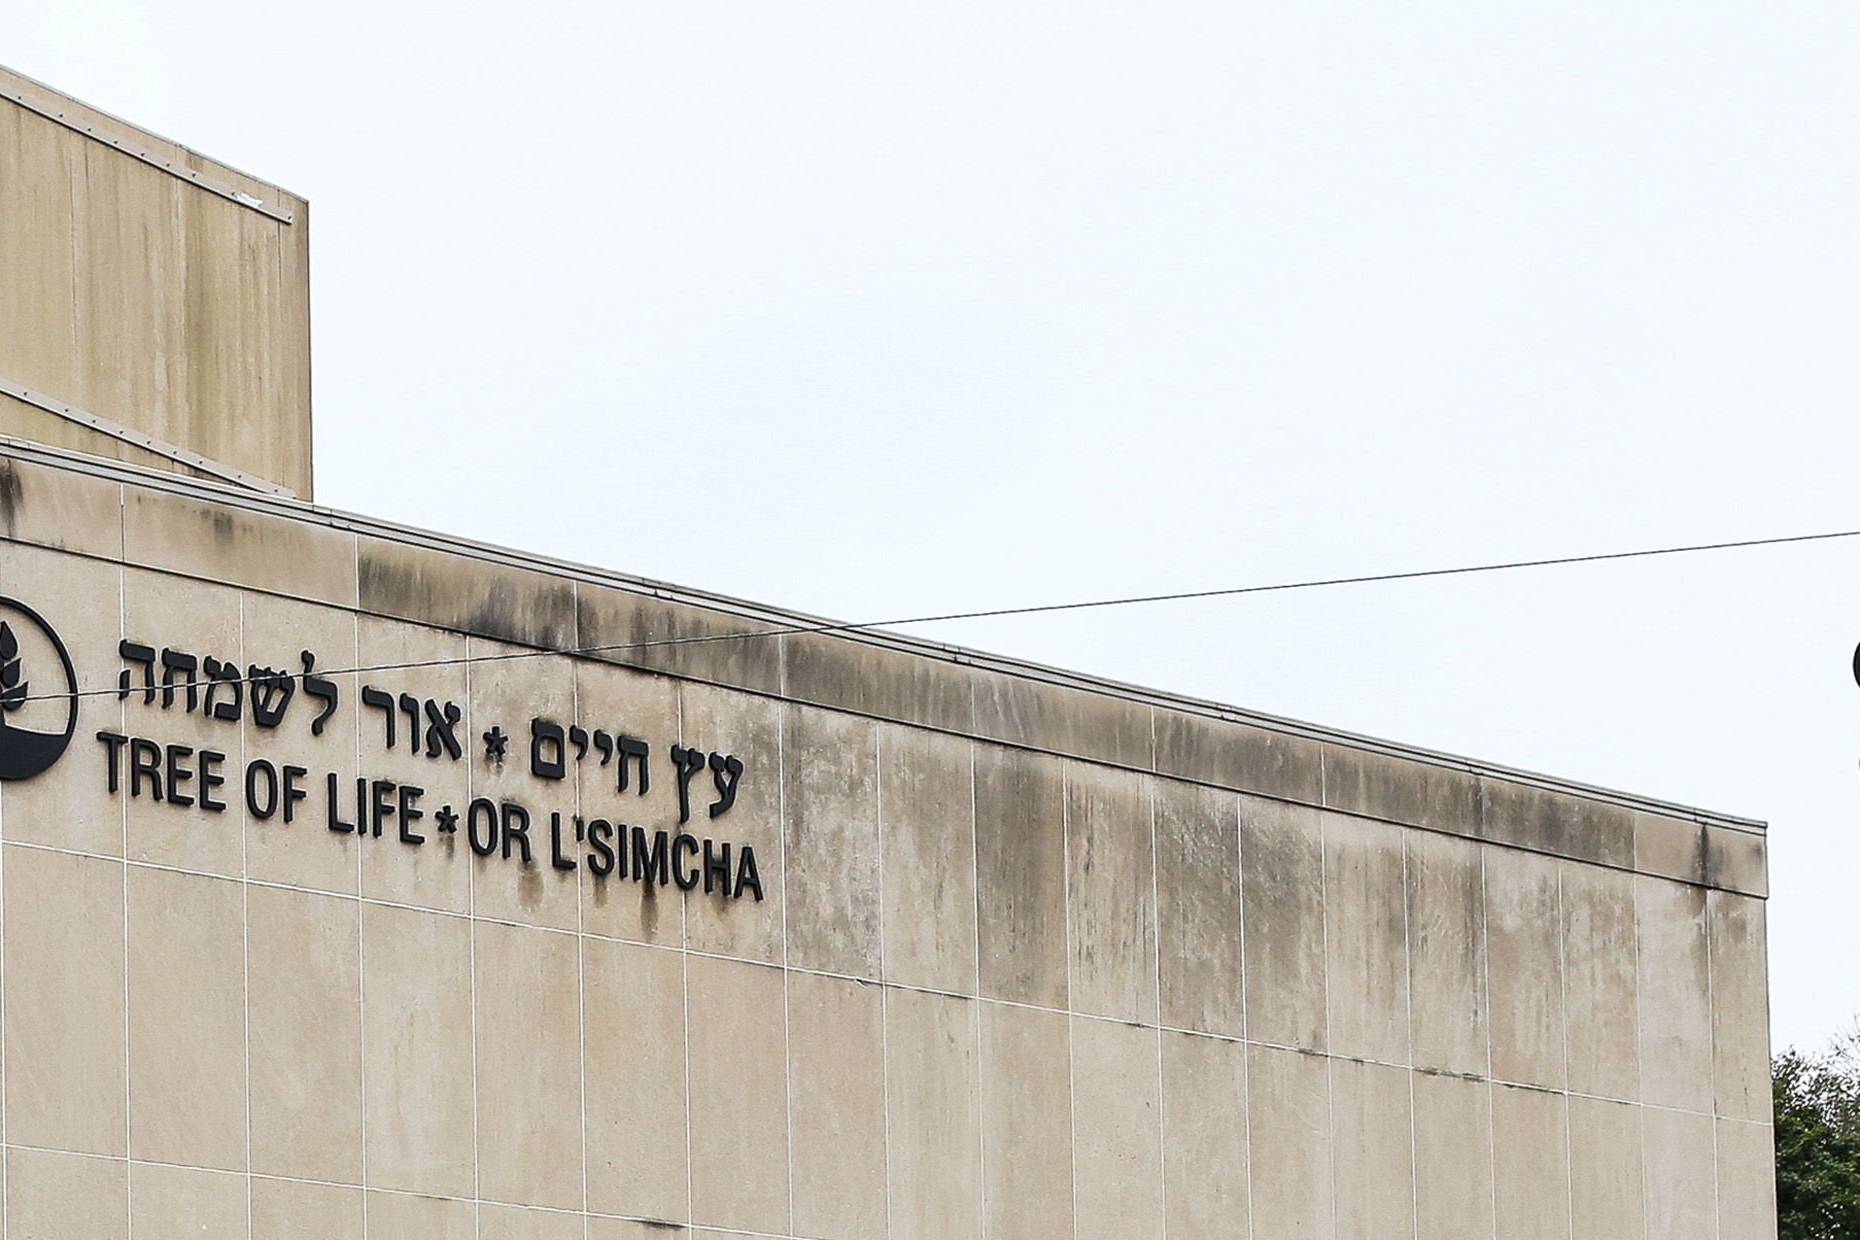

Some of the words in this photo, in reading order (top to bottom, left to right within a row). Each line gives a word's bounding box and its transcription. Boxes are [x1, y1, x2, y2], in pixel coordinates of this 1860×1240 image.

[119, 638, 338, 736] לשמחה
[362, 684, 461, 760] אור
[531, 717, 649, 795] חיים
[671, 744, 743, 823] עץ
[96, 731, 227, 811] TREE
[245, 758, 308, 824] OF
[327, 771, 426, 845] LIFE
[467, 797, 532, 862] OR
[551, 812, 764, 902] L'SIMCHA
